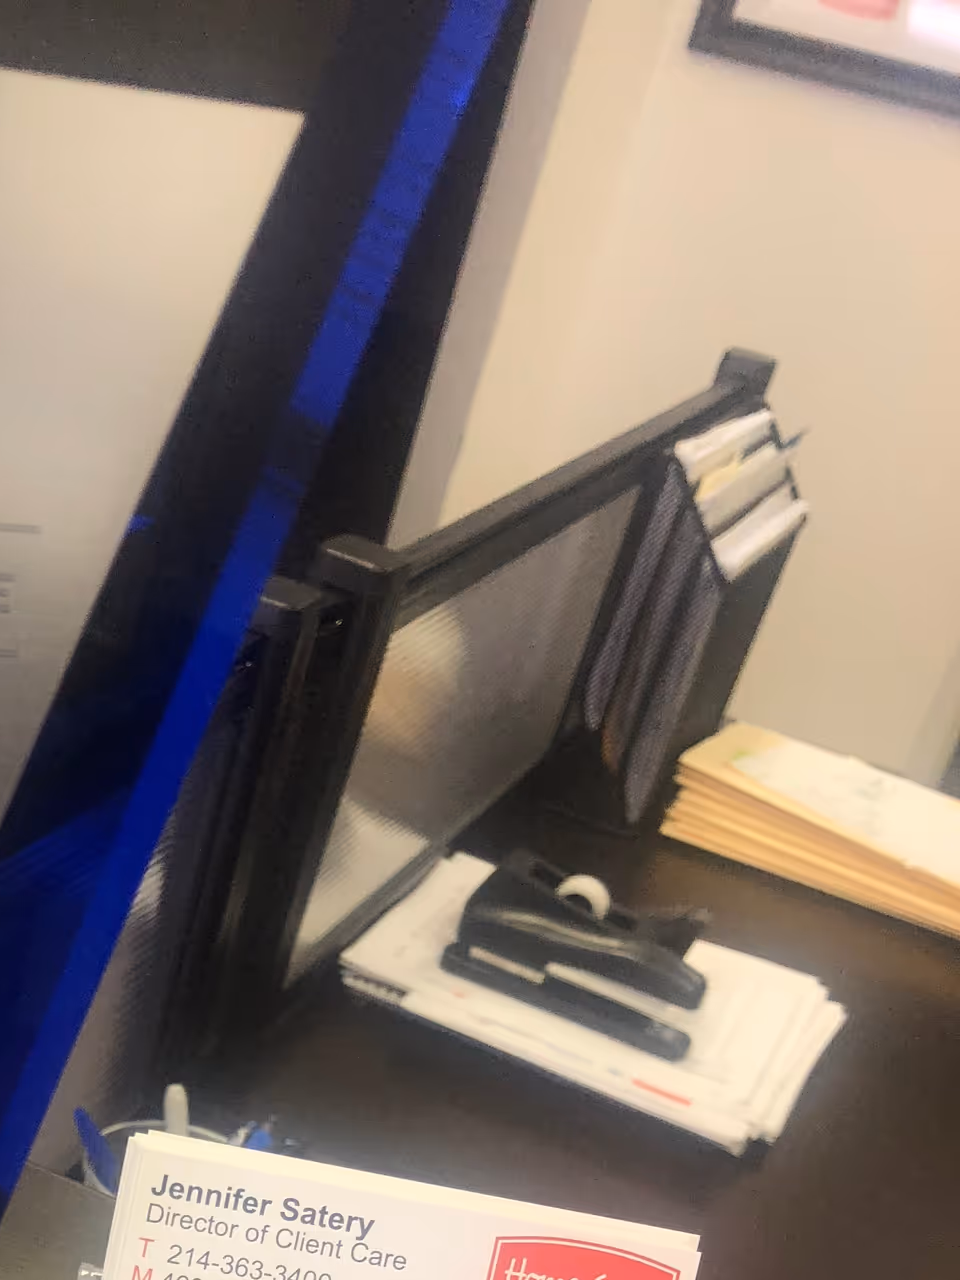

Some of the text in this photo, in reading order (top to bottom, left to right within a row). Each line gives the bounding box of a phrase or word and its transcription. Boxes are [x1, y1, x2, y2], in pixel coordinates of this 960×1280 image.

[146, 1203, 407, 1270] Director of Client Care
[152, 1175, 375, 1240] Jennifer Satery
[138, 1237, 155, 1258] T
